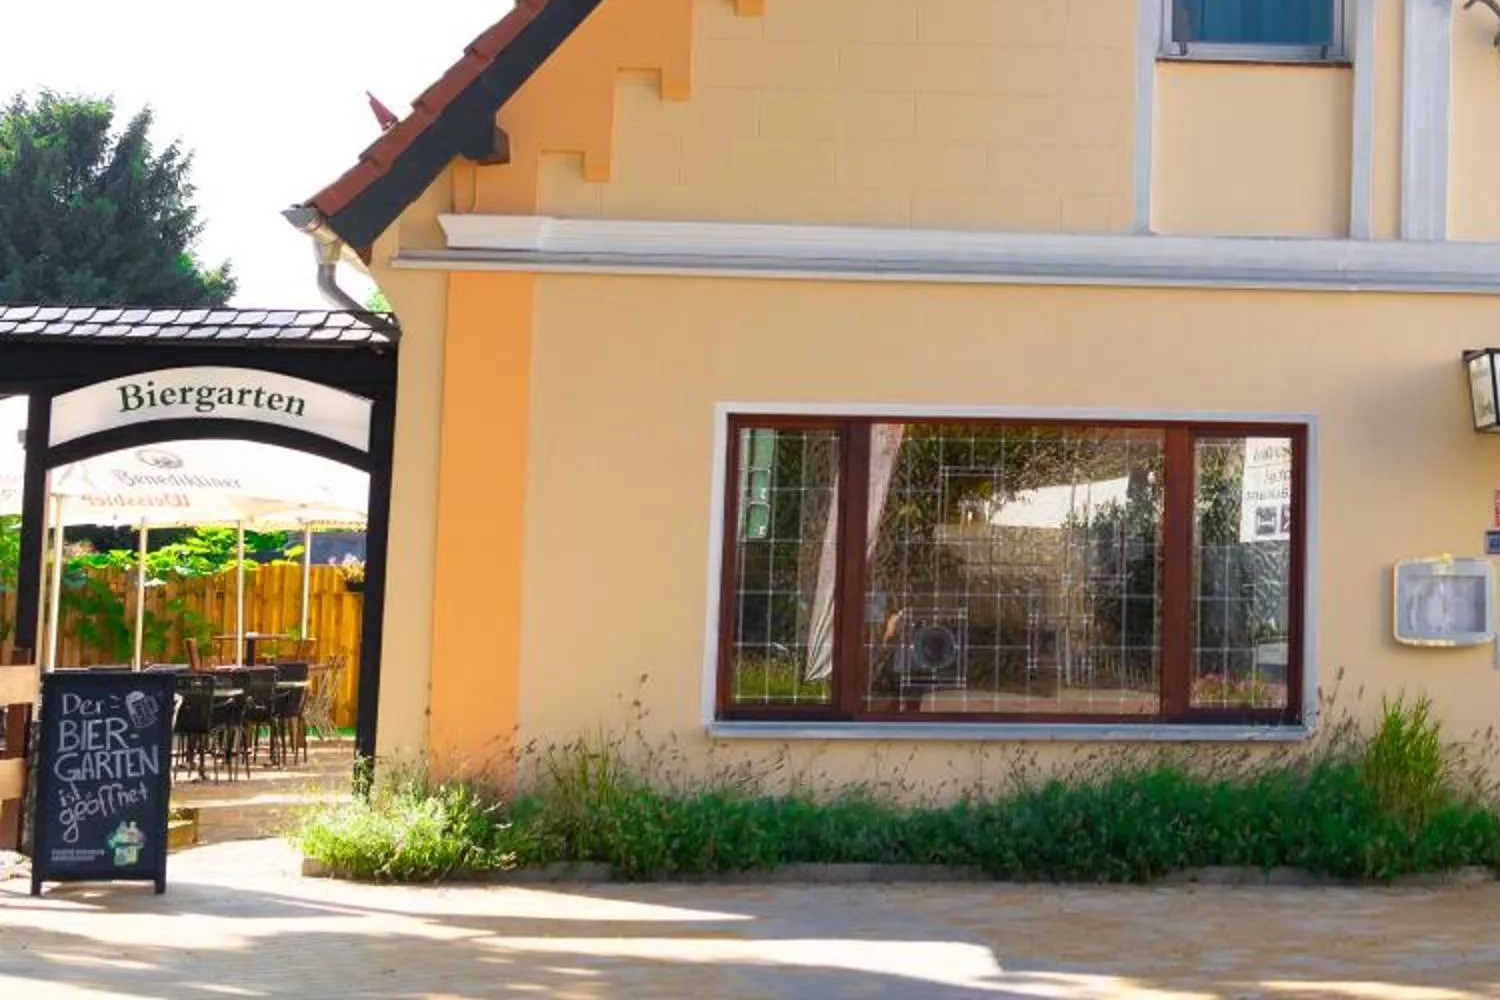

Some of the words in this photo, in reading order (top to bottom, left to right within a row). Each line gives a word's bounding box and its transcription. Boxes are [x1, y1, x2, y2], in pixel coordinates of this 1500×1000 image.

[117, 380, 306, 417] Biergarten
[62, 693, 102, 715] Der
[59, 718, 139, 751] BIER-
[54, 746, 159, 781] GARTEN
